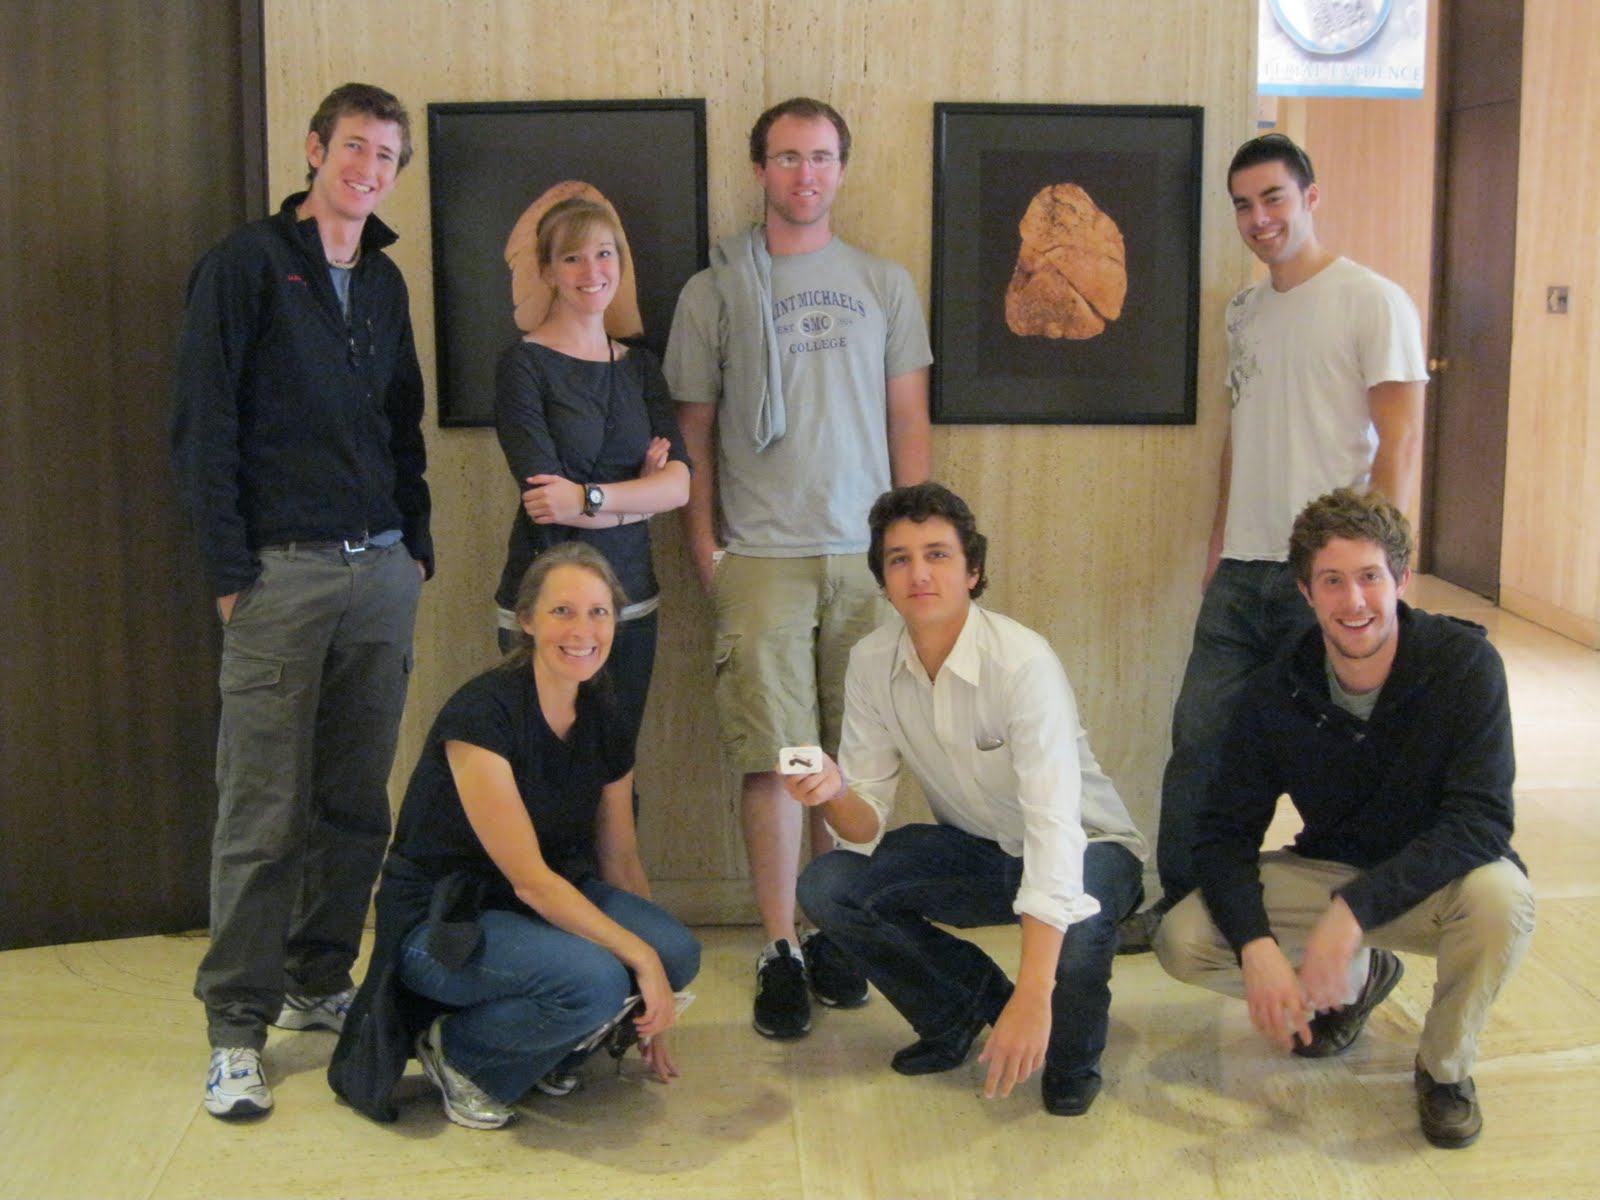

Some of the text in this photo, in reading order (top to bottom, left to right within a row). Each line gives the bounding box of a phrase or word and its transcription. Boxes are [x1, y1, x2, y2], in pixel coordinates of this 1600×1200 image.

[1330, 63, 1422, 82] EVIDENCE
[773, 295, 795, 320] INT
[803, 316, 829, 333] SMC
[789, 337, 847, 354] COLLEGE
